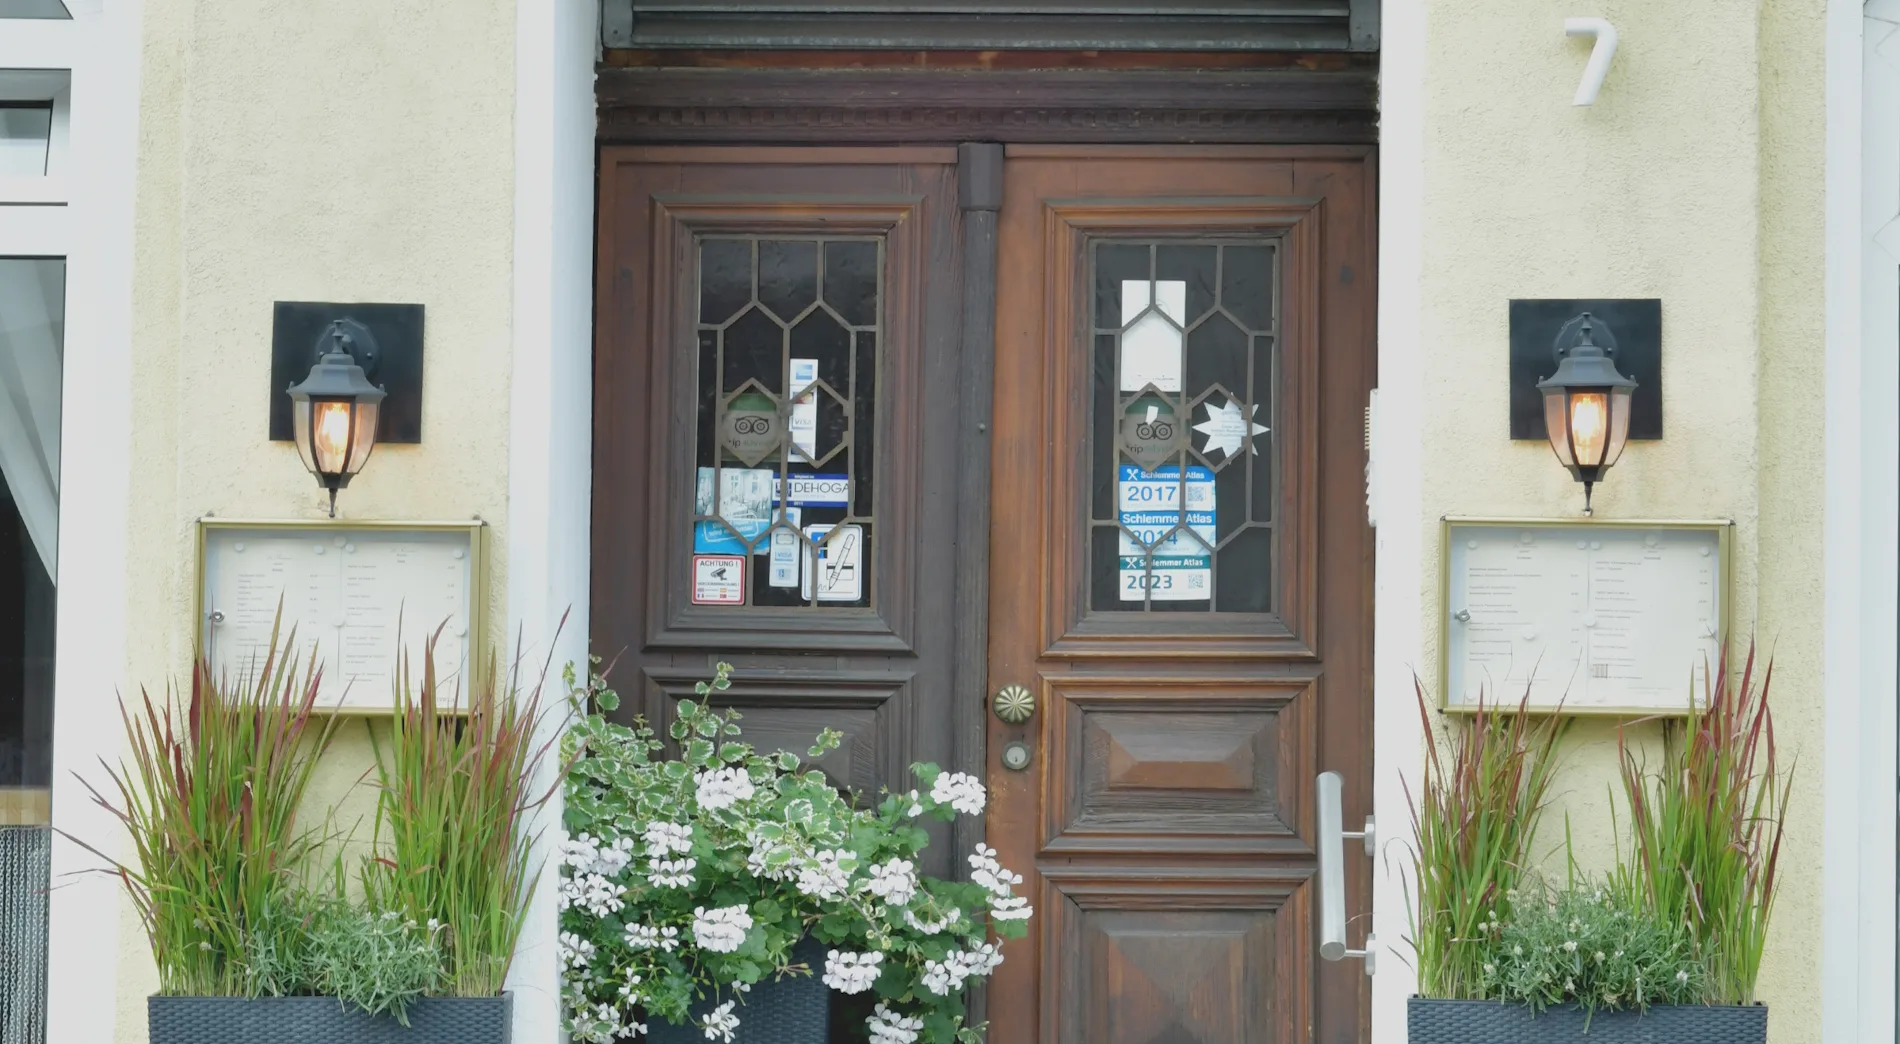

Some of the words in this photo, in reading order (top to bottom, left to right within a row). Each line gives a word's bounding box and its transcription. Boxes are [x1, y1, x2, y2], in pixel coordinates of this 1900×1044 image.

[1564, 16, 1618, 106] 7
[1140, 471, 1180, 479] Schlemme
[794, 482, 848, 493] DEHOGA
[1128, 486, 1177, 501] 2017
[1122, 514, 1180, 524] Schlemme
[1185, 513, 1212, 523] Atlas
[1131, 530, 1178, 545] 2014
[1139, 559, 1182, 567] Sclemmer
[1184, 558, 1203, 566] Atlas
[1127, 575, 1172, 589] 2023
